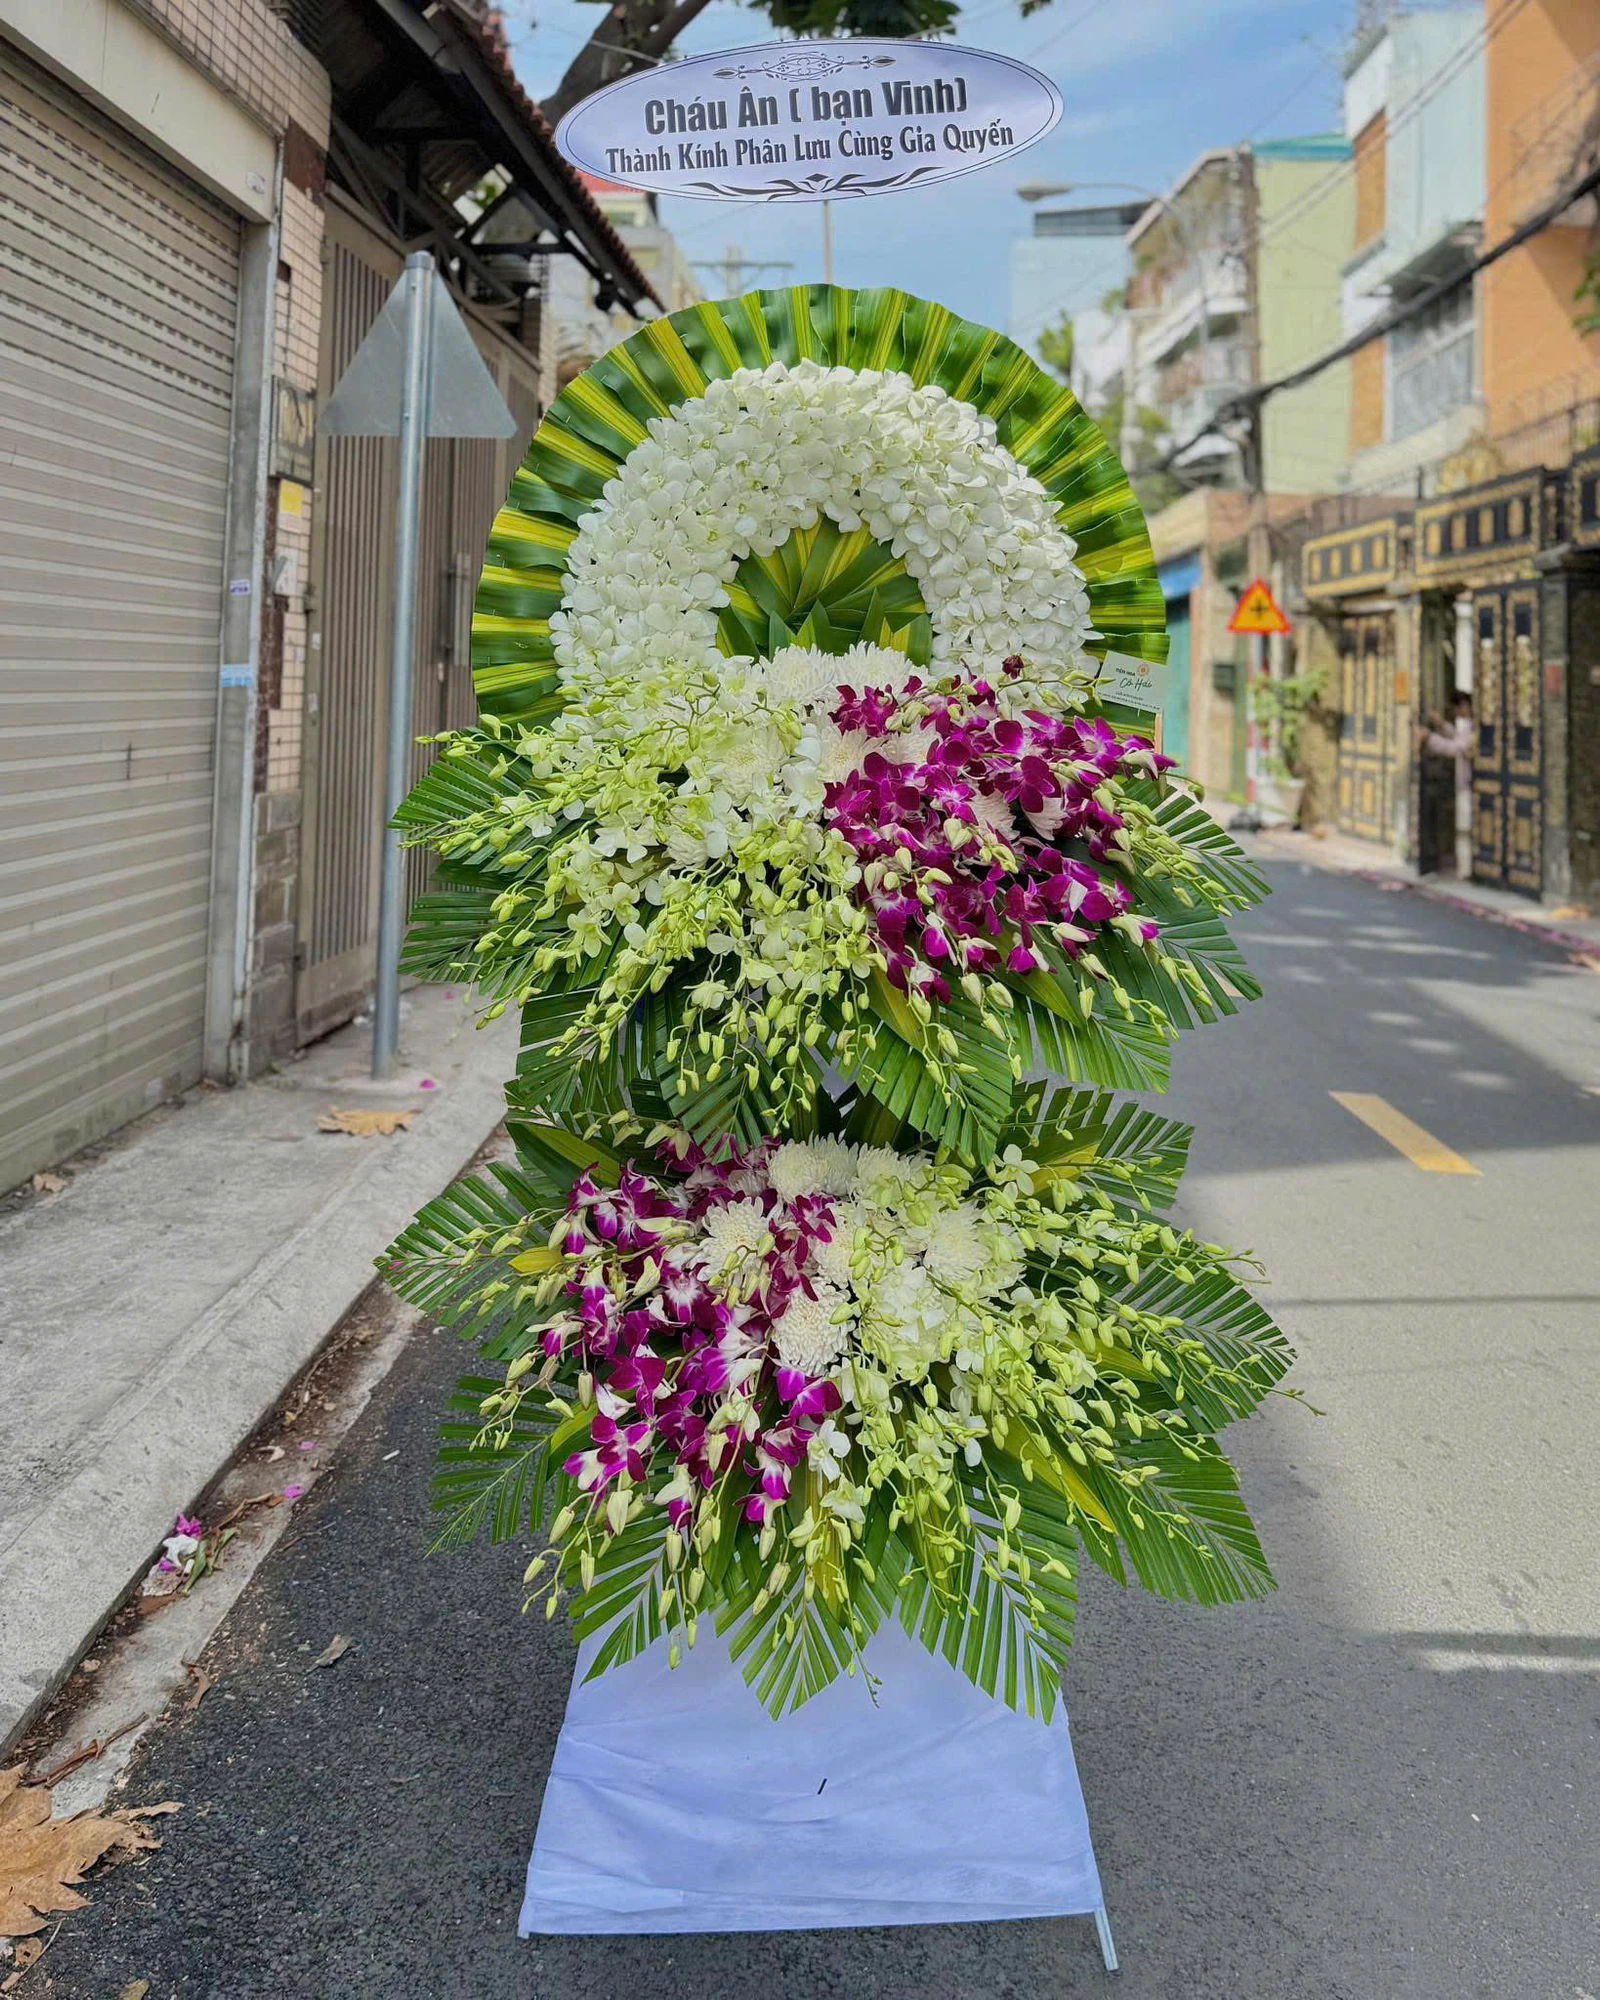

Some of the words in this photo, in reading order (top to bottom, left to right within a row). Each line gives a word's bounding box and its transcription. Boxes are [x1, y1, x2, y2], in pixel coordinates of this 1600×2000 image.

[645, 96, 727, 135] Cháu
[738, 86, 779, 128] Ân
[811, 86, 873, 126] bạn
[605, 144, 671, 174] Thành
[678, 141, 728, 170] Kính
[735, 138, 787, 166] Phân
[794, 134, 831, 161] Lưu
[838, 129, 893, 161] Cùng
[899, 125, 936, 154] Gia
[943, 118, 1014, 153] Quyến
